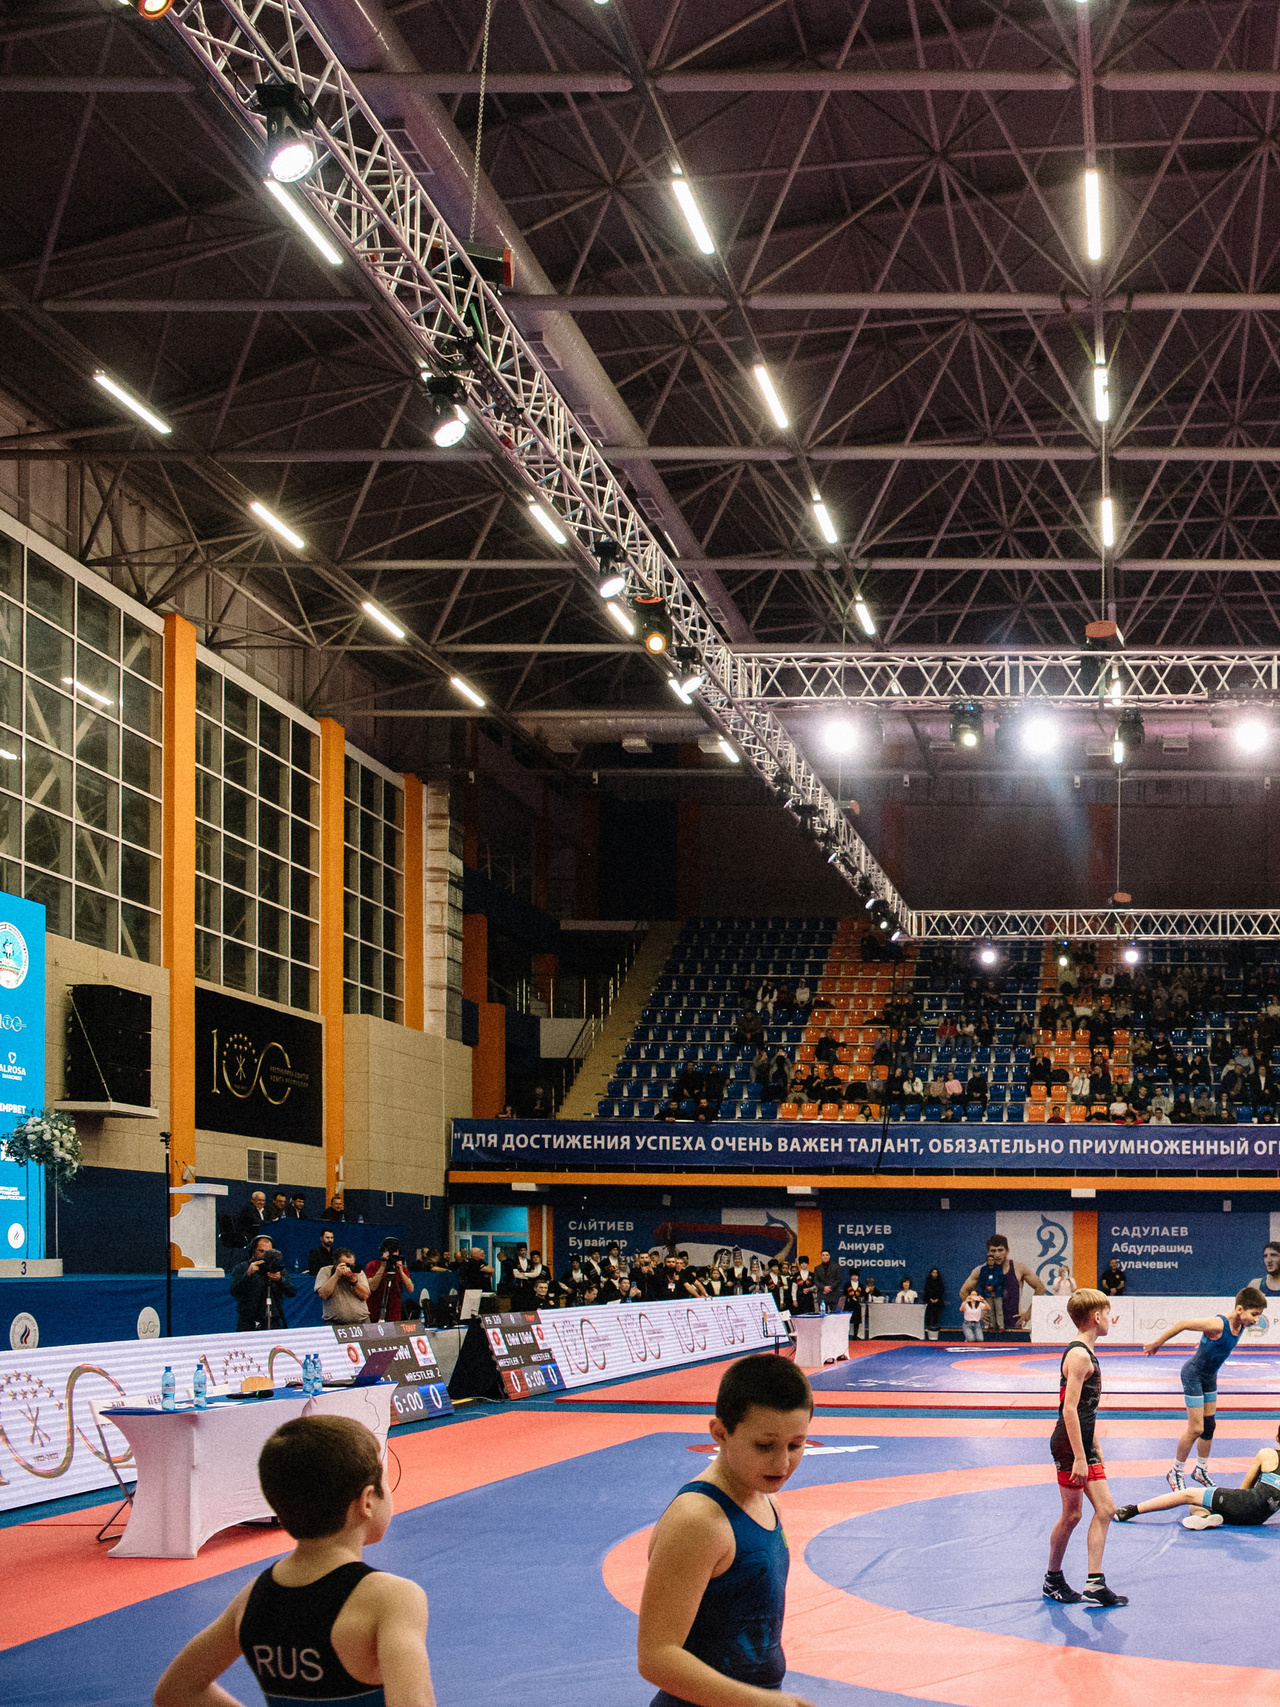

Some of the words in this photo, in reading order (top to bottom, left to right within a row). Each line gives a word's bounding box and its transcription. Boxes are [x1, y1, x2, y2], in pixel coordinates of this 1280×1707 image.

[0, 1064, 26, 1076] ALROSA
[453, 1132, 498, 1151] "ДЛЯ
[502, 1134, 631, 1151] ДОСТИЖЕНИЯ
[635, 1135, 705, 1152] УСПЕХА
[711, 1136, 772, 1152] ОЧЕНЬ
[778, 1137, 842, 1153] ВАЖЕН
[847, 1137, 923, 1155] ТАЛАНТ,
[929, 1138, 1064, 1155] ОБЯЗАТЕЛЬНО
[1069, 1138, 1249, 1156] ПРИУМНОЖЕННЫЙ
[568, 1219, 634, 1231] САЙТИЕВ
[838, 1224, 892, 1236] ГЕДУЕВ
[1111, 1226, 1189, 1238] САДУЛАЕВ
[838, 1241, 885, 1254] Аниуар
[1112, 1243, 1193, 1256] Абдулрашид
[21, 1261, 27, 1275] 3
[838, 1257, 906, 1269] Борисович
[337, 1329, 348, 1339] FS
[348, 1326, 363, 1338] 120
[377, 1325, 384, 1336] 0
[400, 1323, 417, 1333] Tour
[405, 1370, 435, 1382] WRESTLER
[436, 1367, 442, 1377] 2
[524, 1370, 546, 1388] 6:00
[547, 1365, 558, 1385] 0
[510, 1371, 521, 1393] 0
[393, 1392, 424, 1414] 6:00
[429, 1384, 443, 1409] 0
[252, 1644, 325, 1683] RUS
